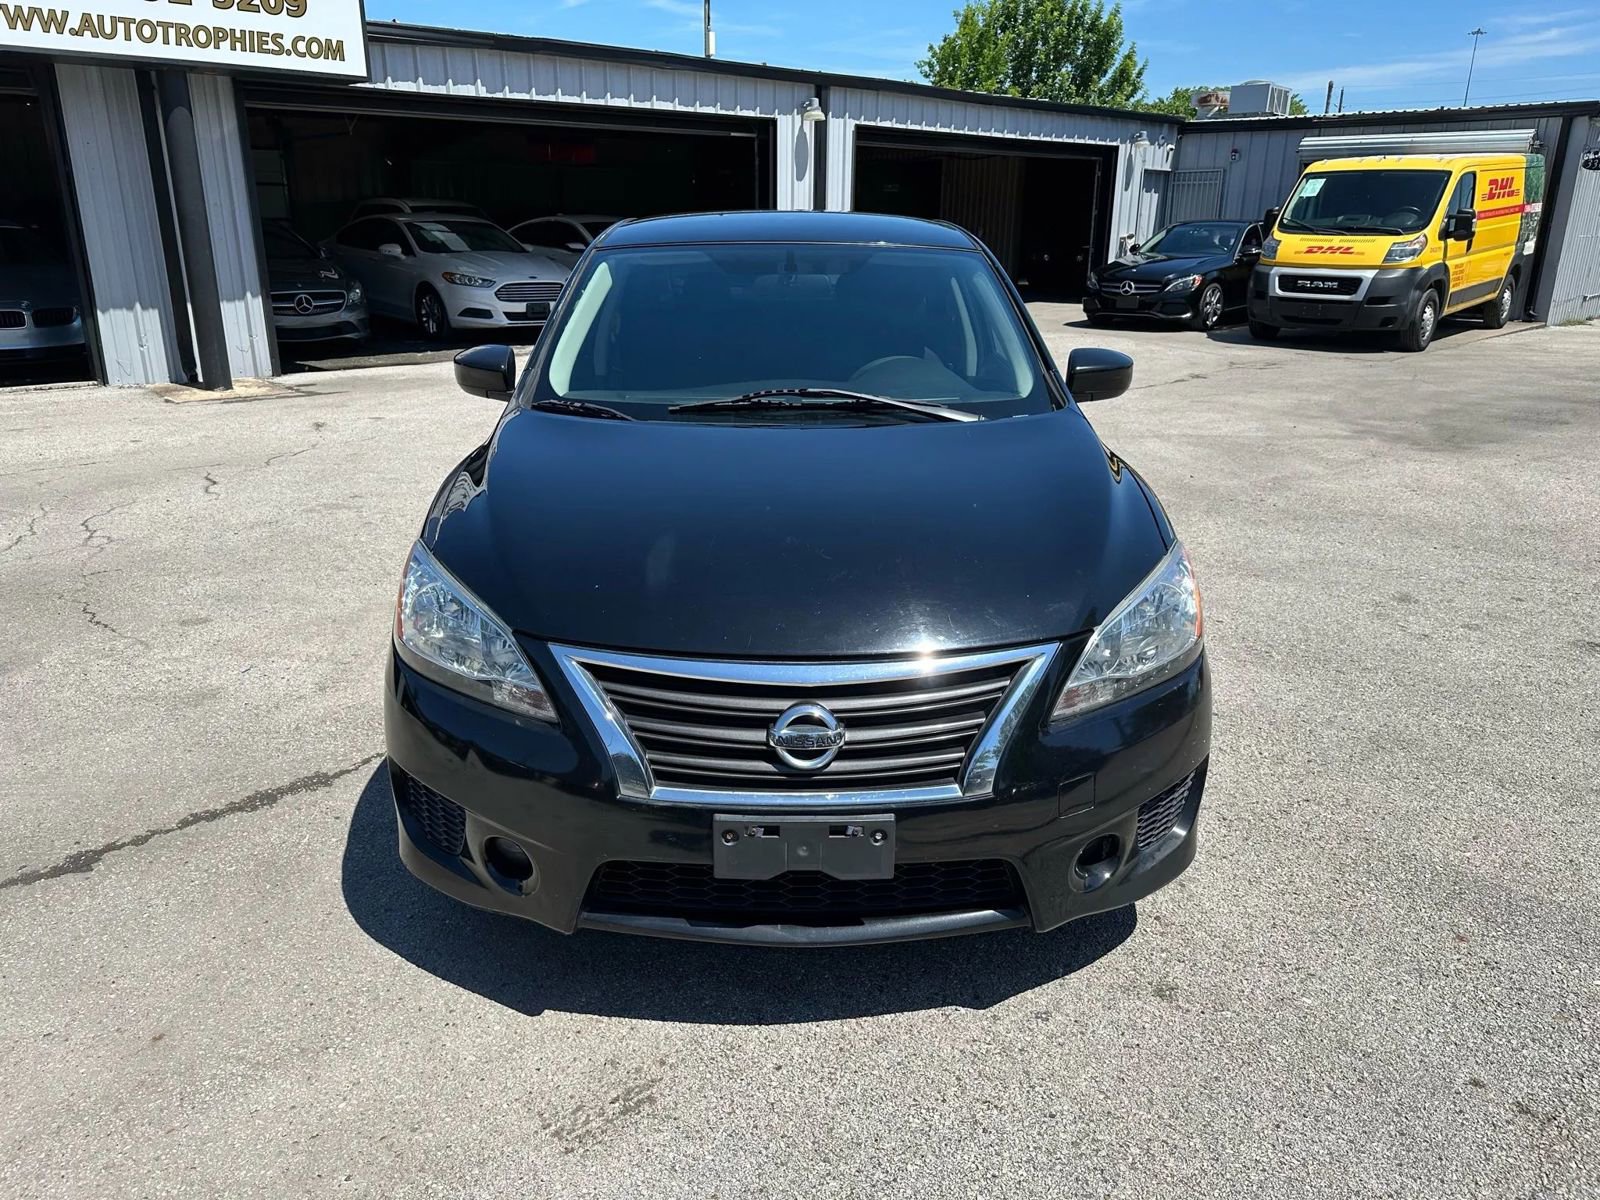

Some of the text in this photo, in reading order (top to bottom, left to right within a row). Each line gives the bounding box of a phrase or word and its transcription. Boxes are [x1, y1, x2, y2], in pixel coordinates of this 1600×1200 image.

[0, 3, 345, 61] WW.AUTOTROPHIES.COM
[1487, 176, 1515, 200] DHL
[1303, 245, 1355, 255] DHL
[1297, 280, 1339, 289] RAM
[776, 735, 837, 747] NISSAN
